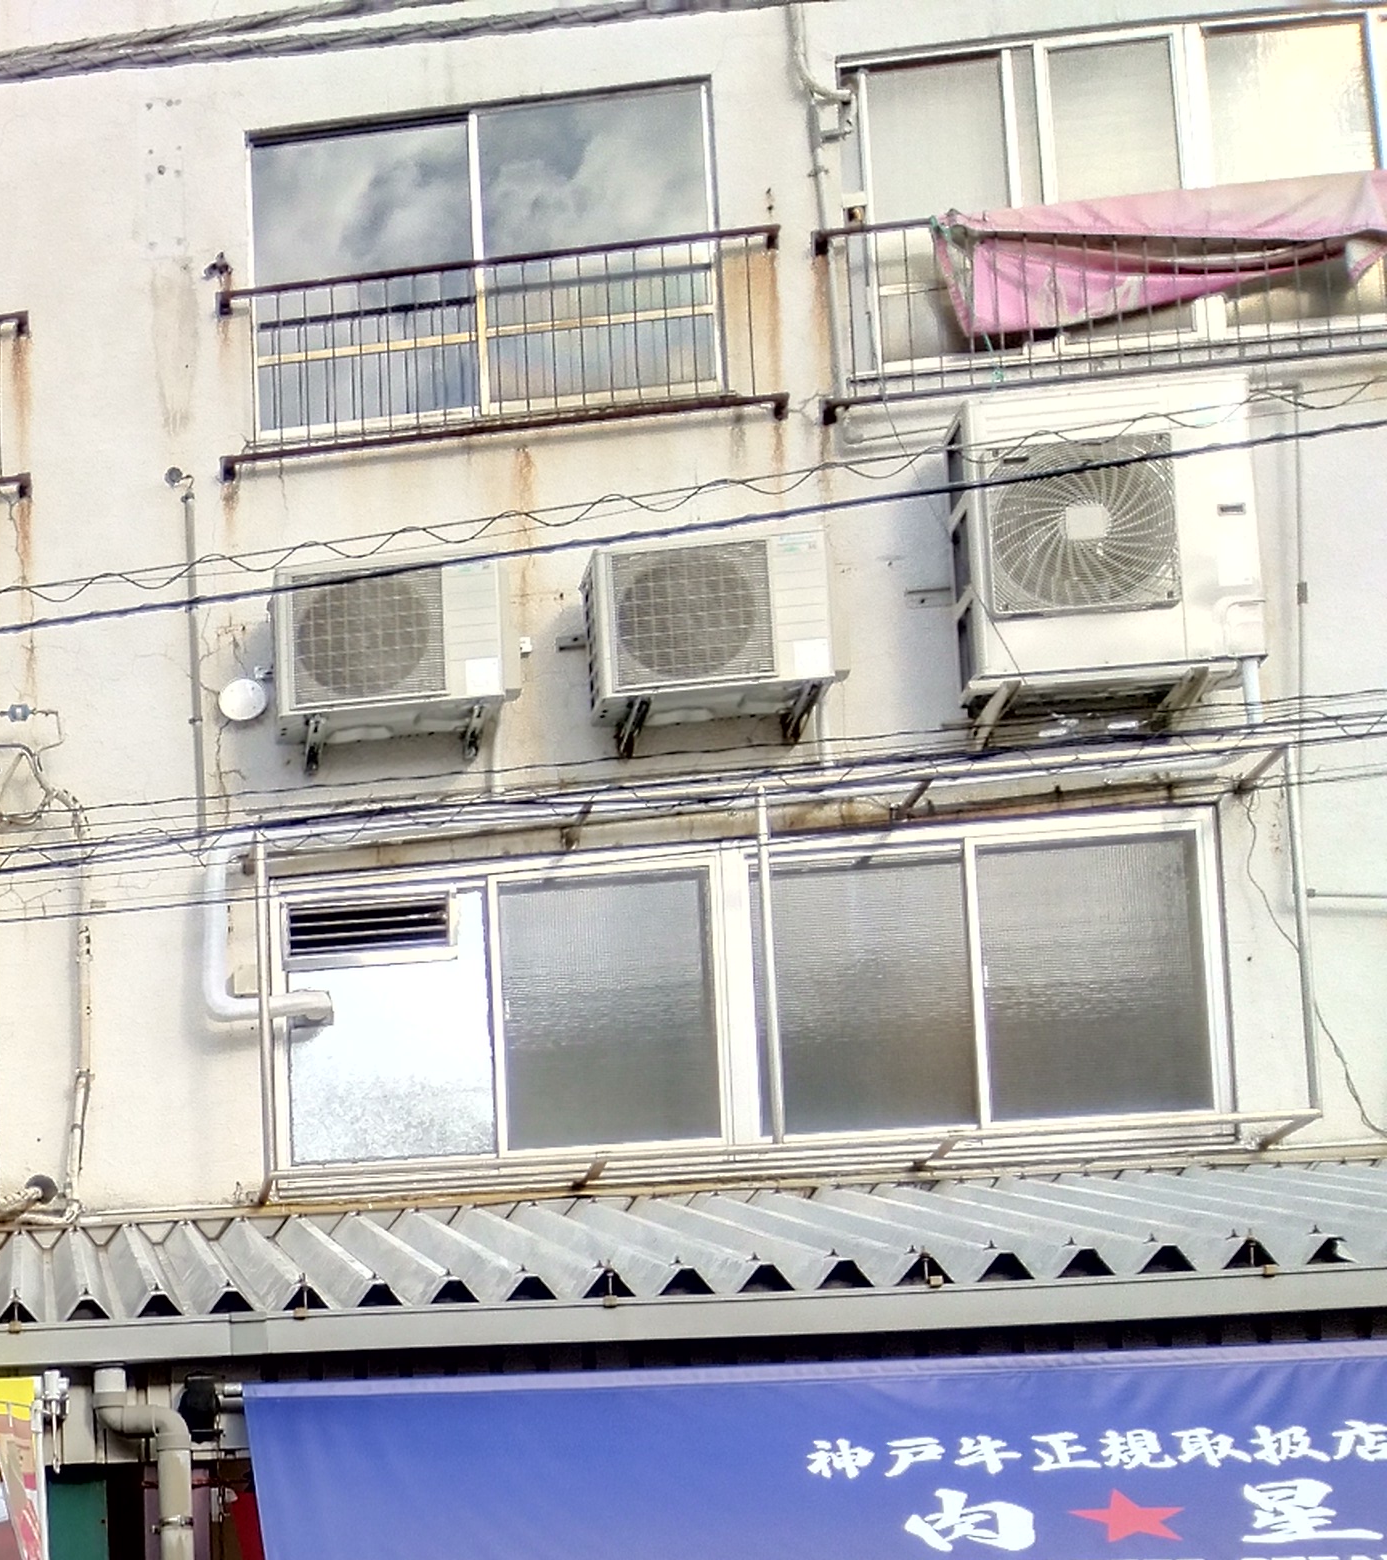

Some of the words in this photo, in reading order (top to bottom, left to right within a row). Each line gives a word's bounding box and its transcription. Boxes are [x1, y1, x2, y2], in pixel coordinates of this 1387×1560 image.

[806, 1420, 1387, 1479] 神戸牛正規取扱店
[904, 1488, 1036, 1551] 肉
[1241, 1477, 1384, 1544] 星
